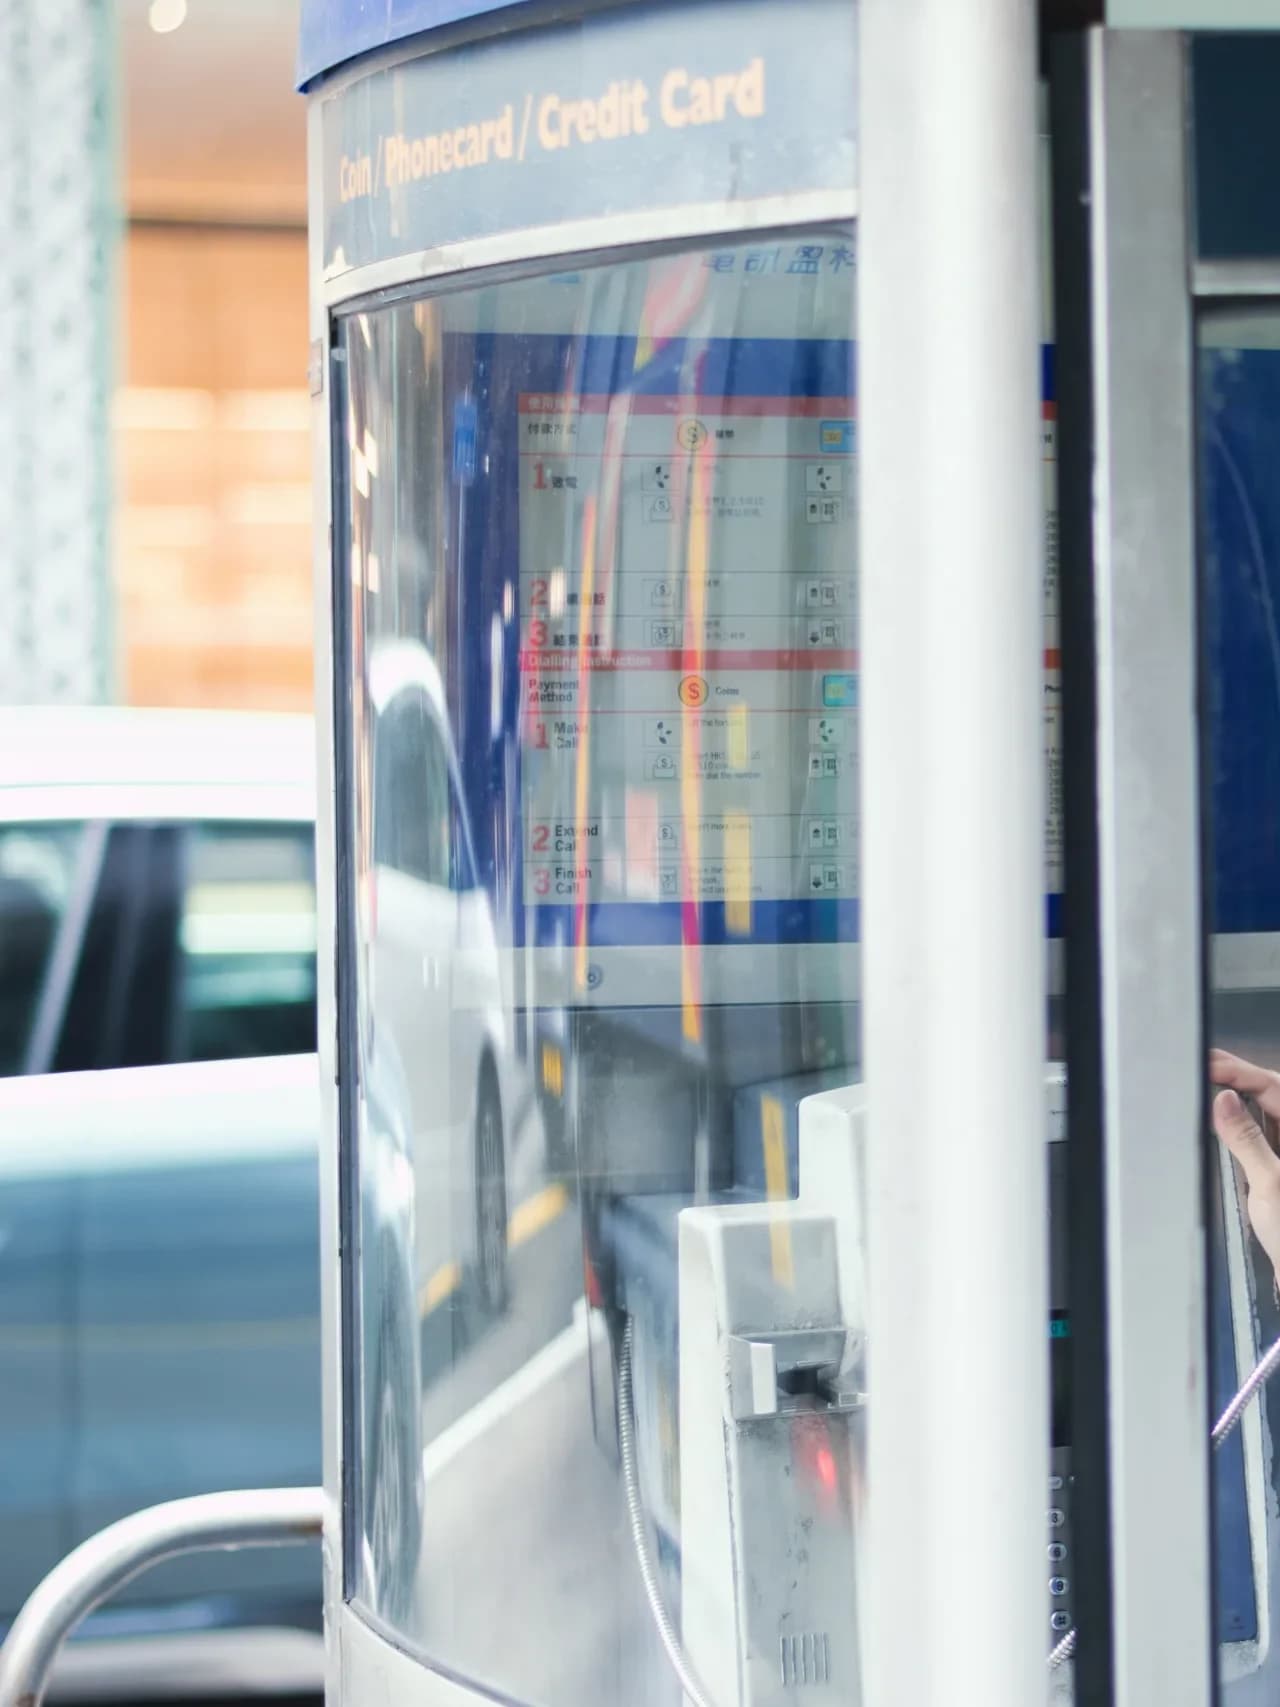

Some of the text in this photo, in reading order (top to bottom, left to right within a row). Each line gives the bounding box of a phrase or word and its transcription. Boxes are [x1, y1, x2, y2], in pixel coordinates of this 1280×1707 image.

[660, 57, 765, 129] Card
[529, 692, 573, 702] Method
[555, 737, 580, 749] Cal
[532, 825, 551, 852] 2
[555, 840, 581, 852] Cal
[533, 868, 551, 895] 3
